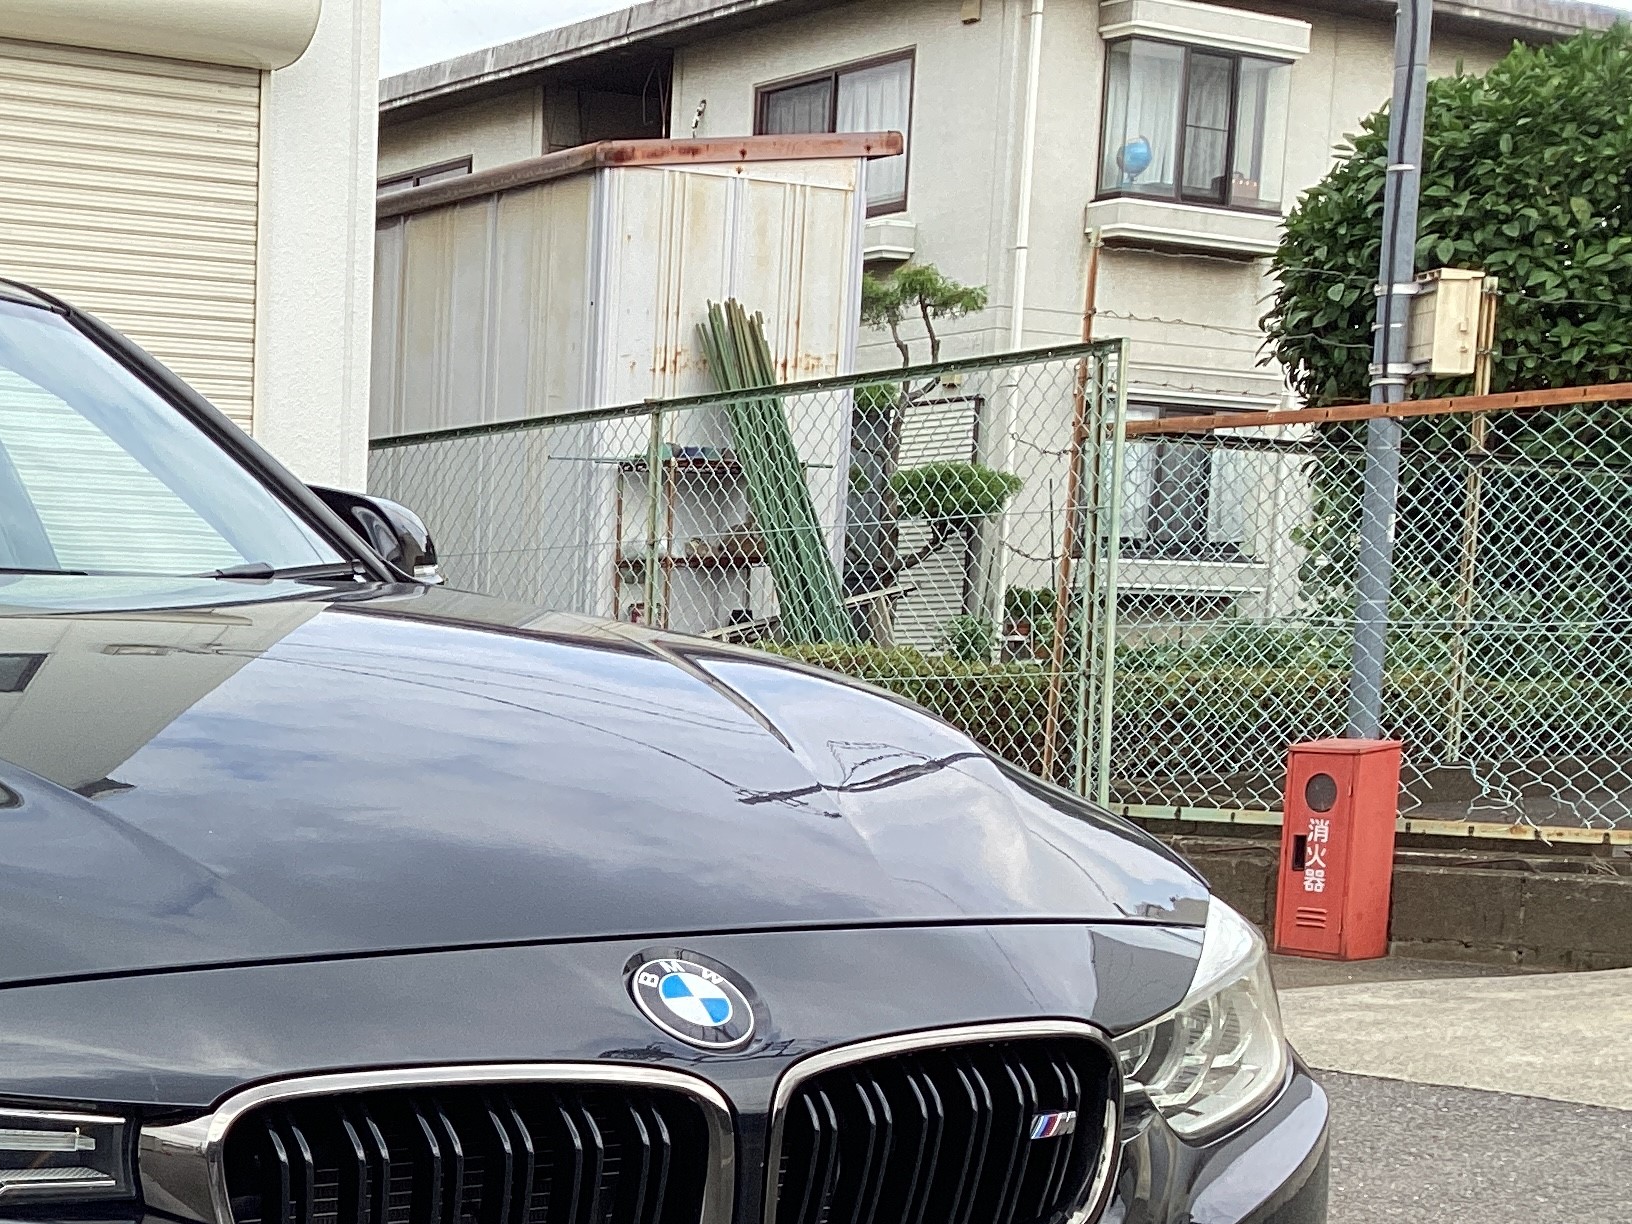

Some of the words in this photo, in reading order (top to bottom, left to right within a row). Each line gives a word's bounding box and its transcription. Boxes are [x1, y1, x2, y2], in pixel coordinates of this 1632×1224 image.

[1303, 818, 1330, 893] 消火器
[638, 960, 724, 988] BMW
